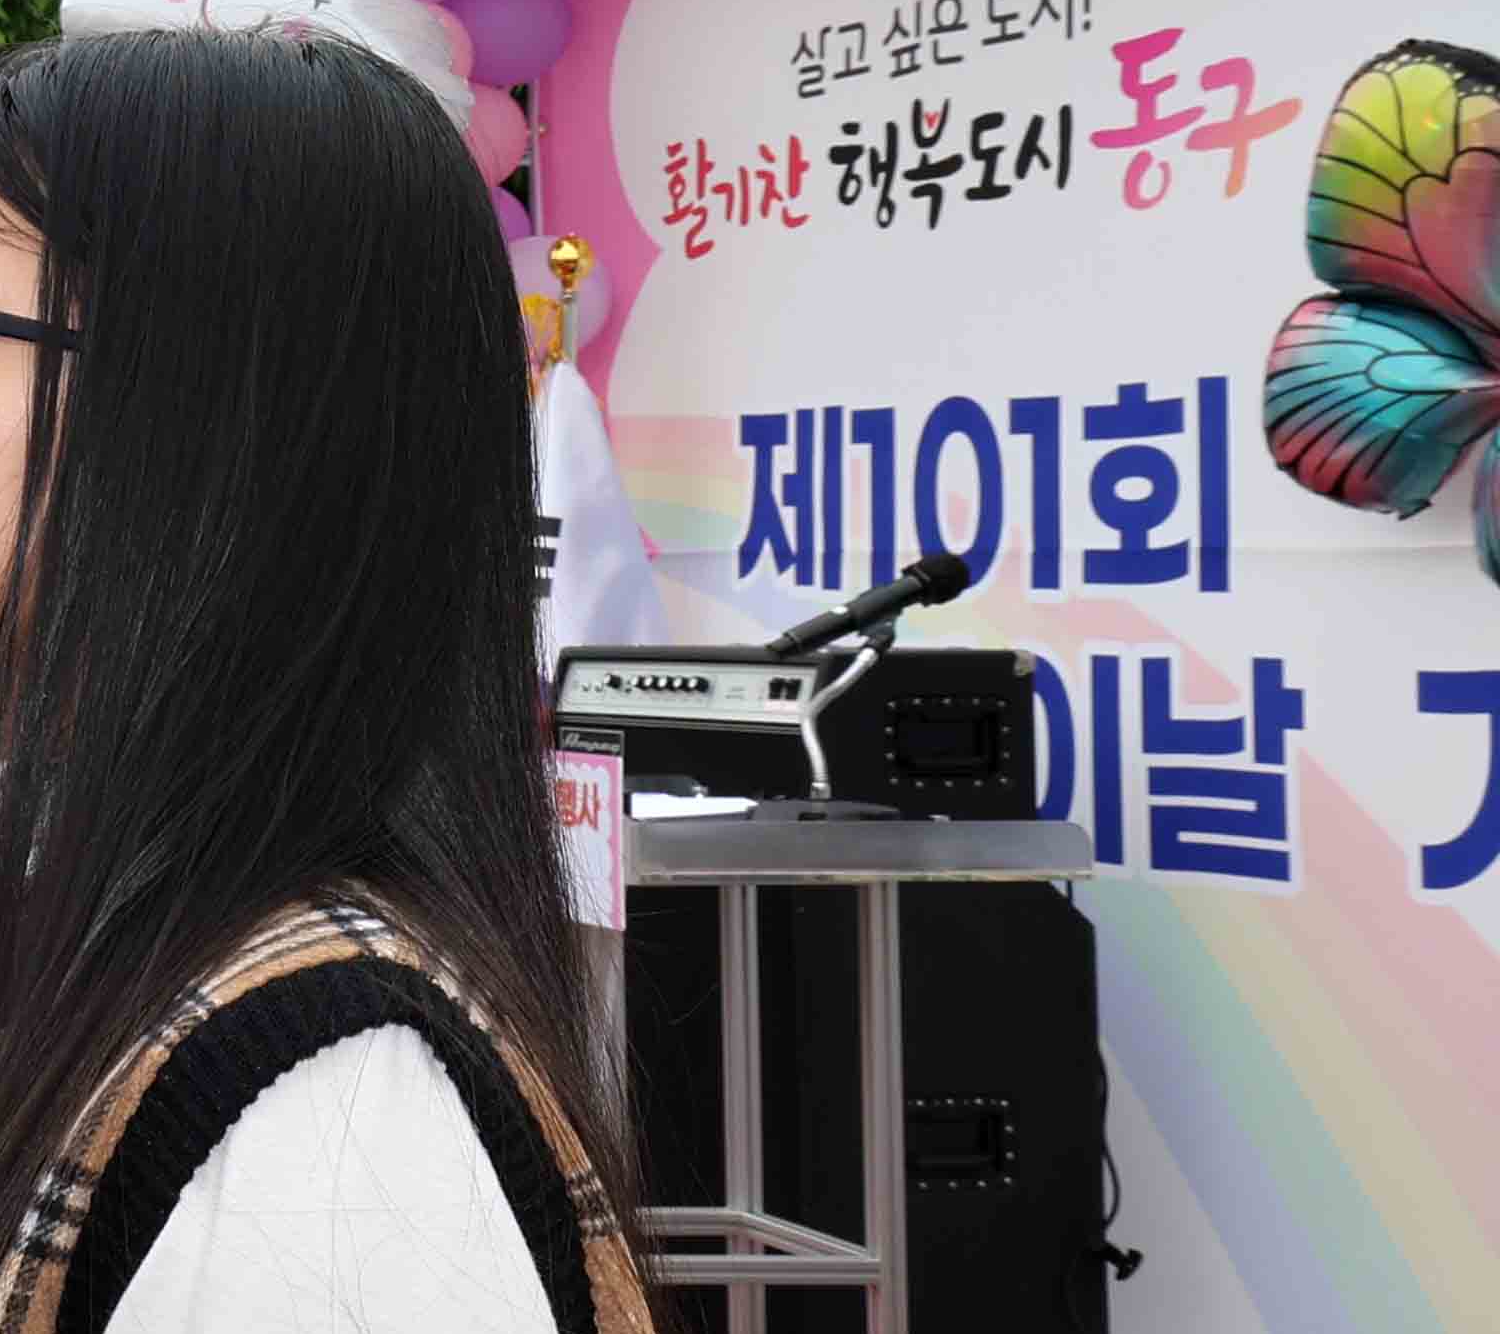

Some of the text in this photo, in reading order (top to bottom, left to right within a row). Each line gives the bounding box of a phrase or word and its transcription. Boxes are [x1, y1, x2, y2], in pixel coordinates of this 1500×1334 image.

[662, 26, 1304, 260] 활기찬 행복도시 동구
[790, 22, 871, 99] 살고
[737, 375, 1230, 593] 제101회
